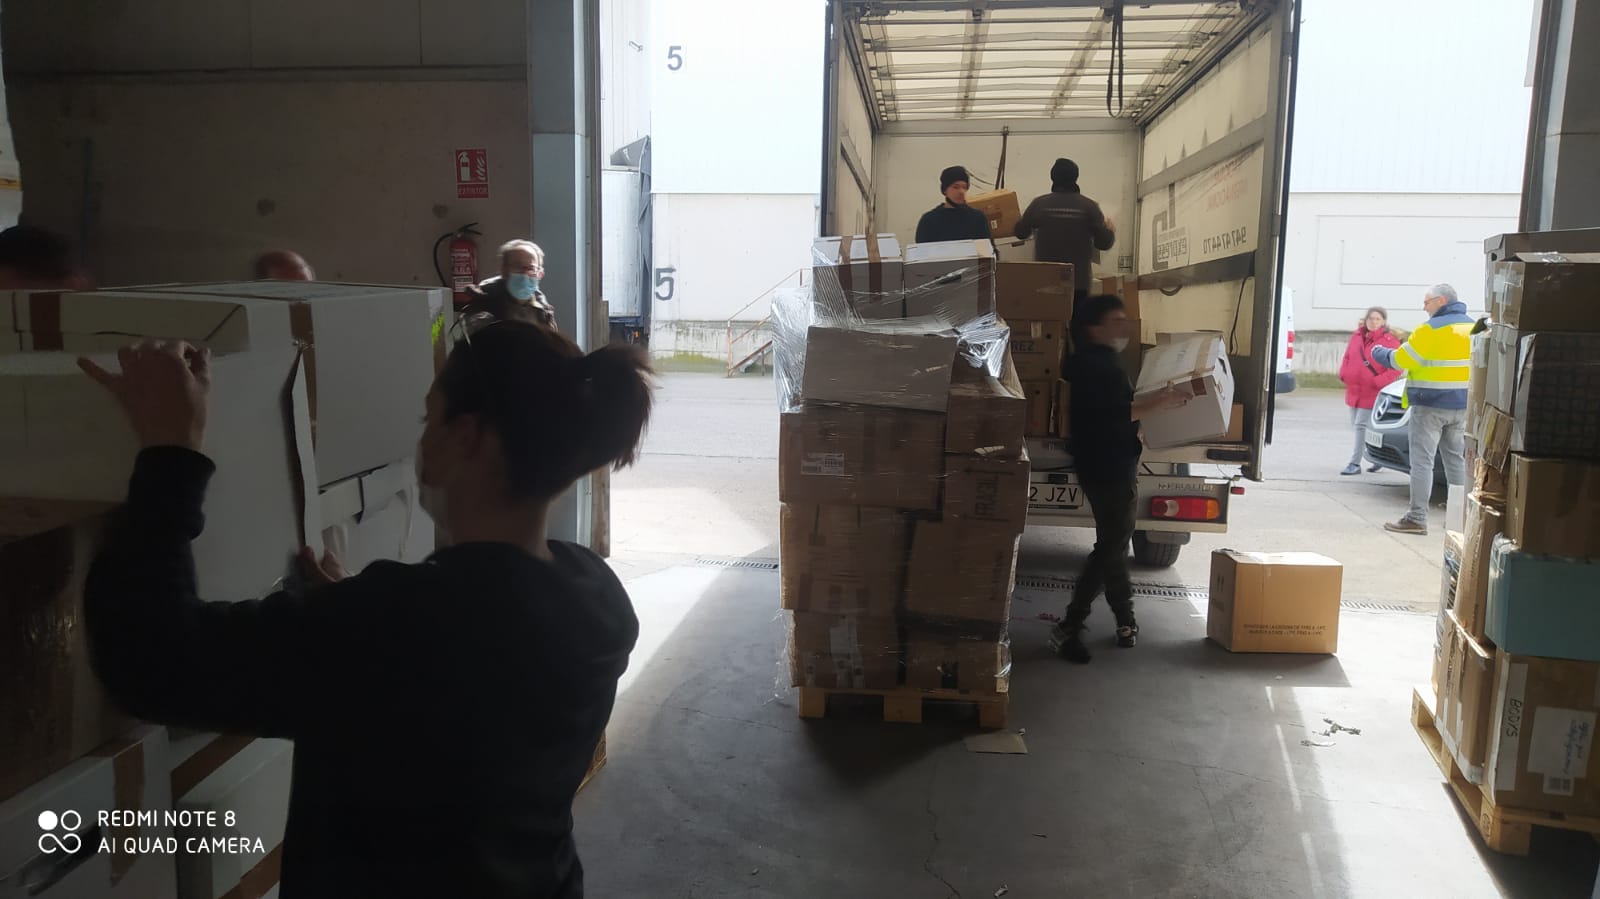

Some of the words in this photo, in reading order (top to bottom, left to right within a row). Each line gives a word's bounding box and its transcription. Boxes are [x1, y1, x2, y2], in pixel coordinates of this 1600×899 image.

[667, 45, 684, 71] 5
[655, 266, 677, 302] 5
[1045, 487, 1078, 503] JZV
